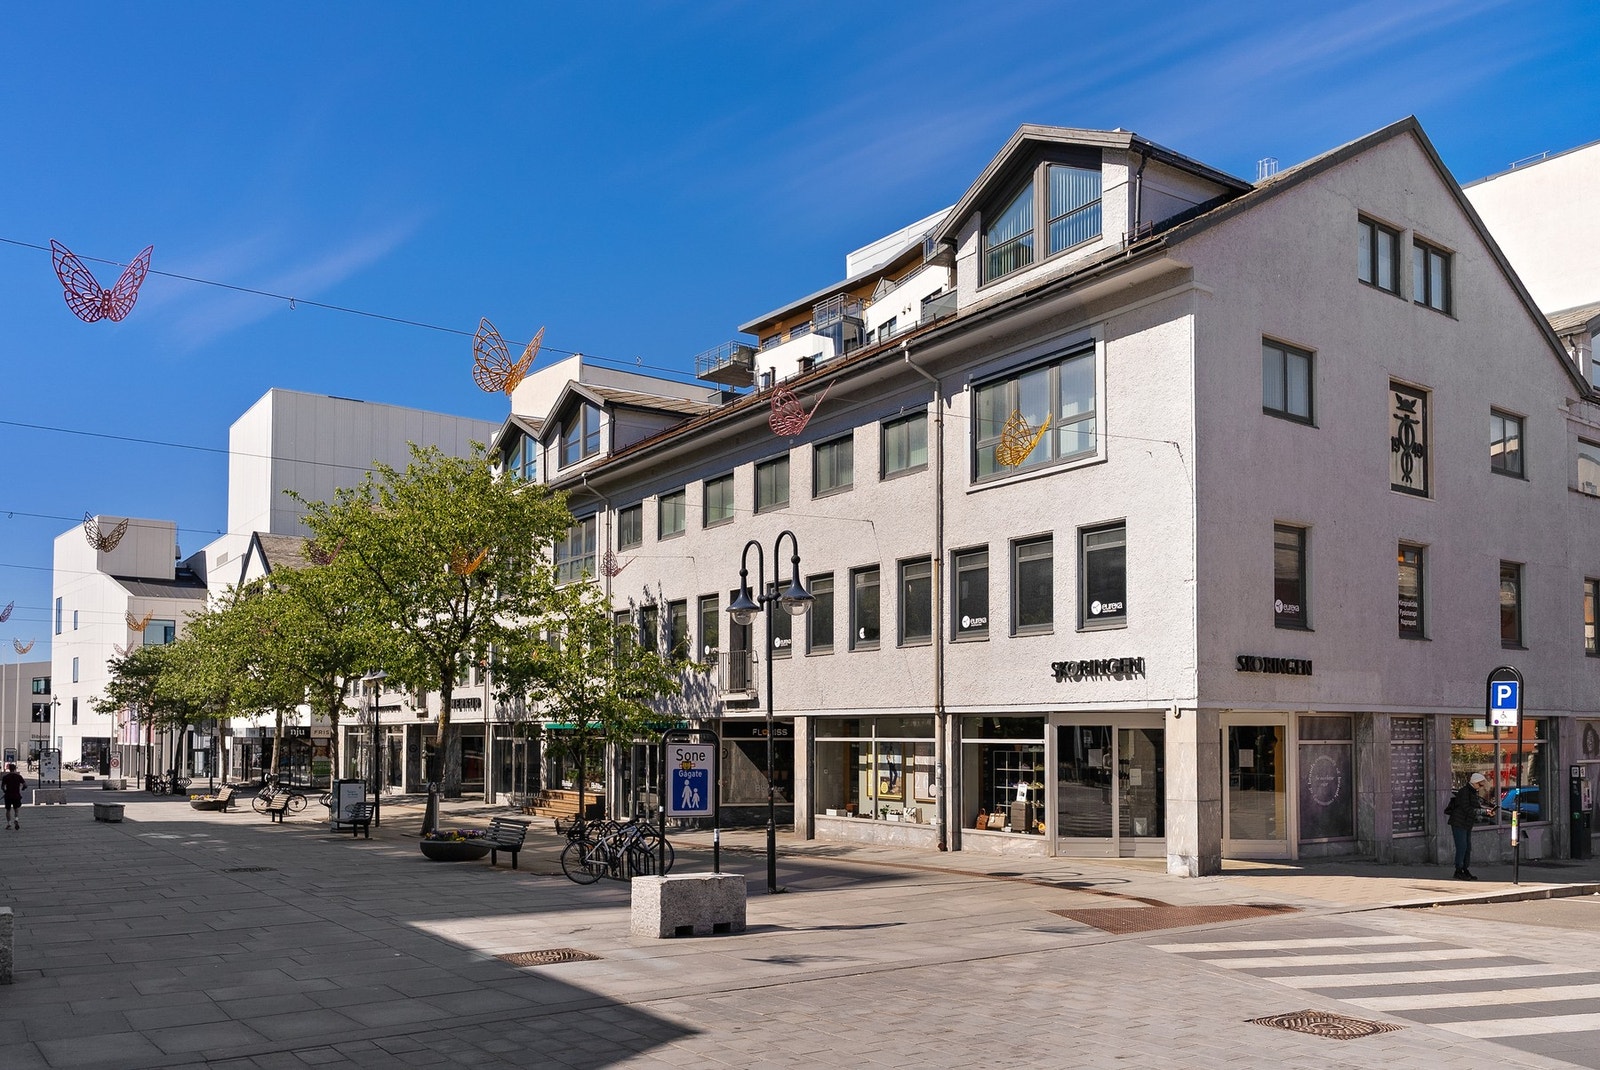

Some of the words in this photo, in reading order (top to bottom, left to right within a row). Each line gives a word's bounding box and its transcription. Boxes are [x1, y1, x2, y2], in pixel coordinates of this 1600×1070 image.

[1102, 601, 1123, 610] eureka
[1051, 657, 1145, 678] SKORINGEN
[1235, 655, 1312, 675] SKORINGEN
[1497, 685, 1512, 707] P
[752, 728, 788, 736] FLOISS
[676, 748, 706, 761] Sone
[678, 769, 703, 779] Gågate
